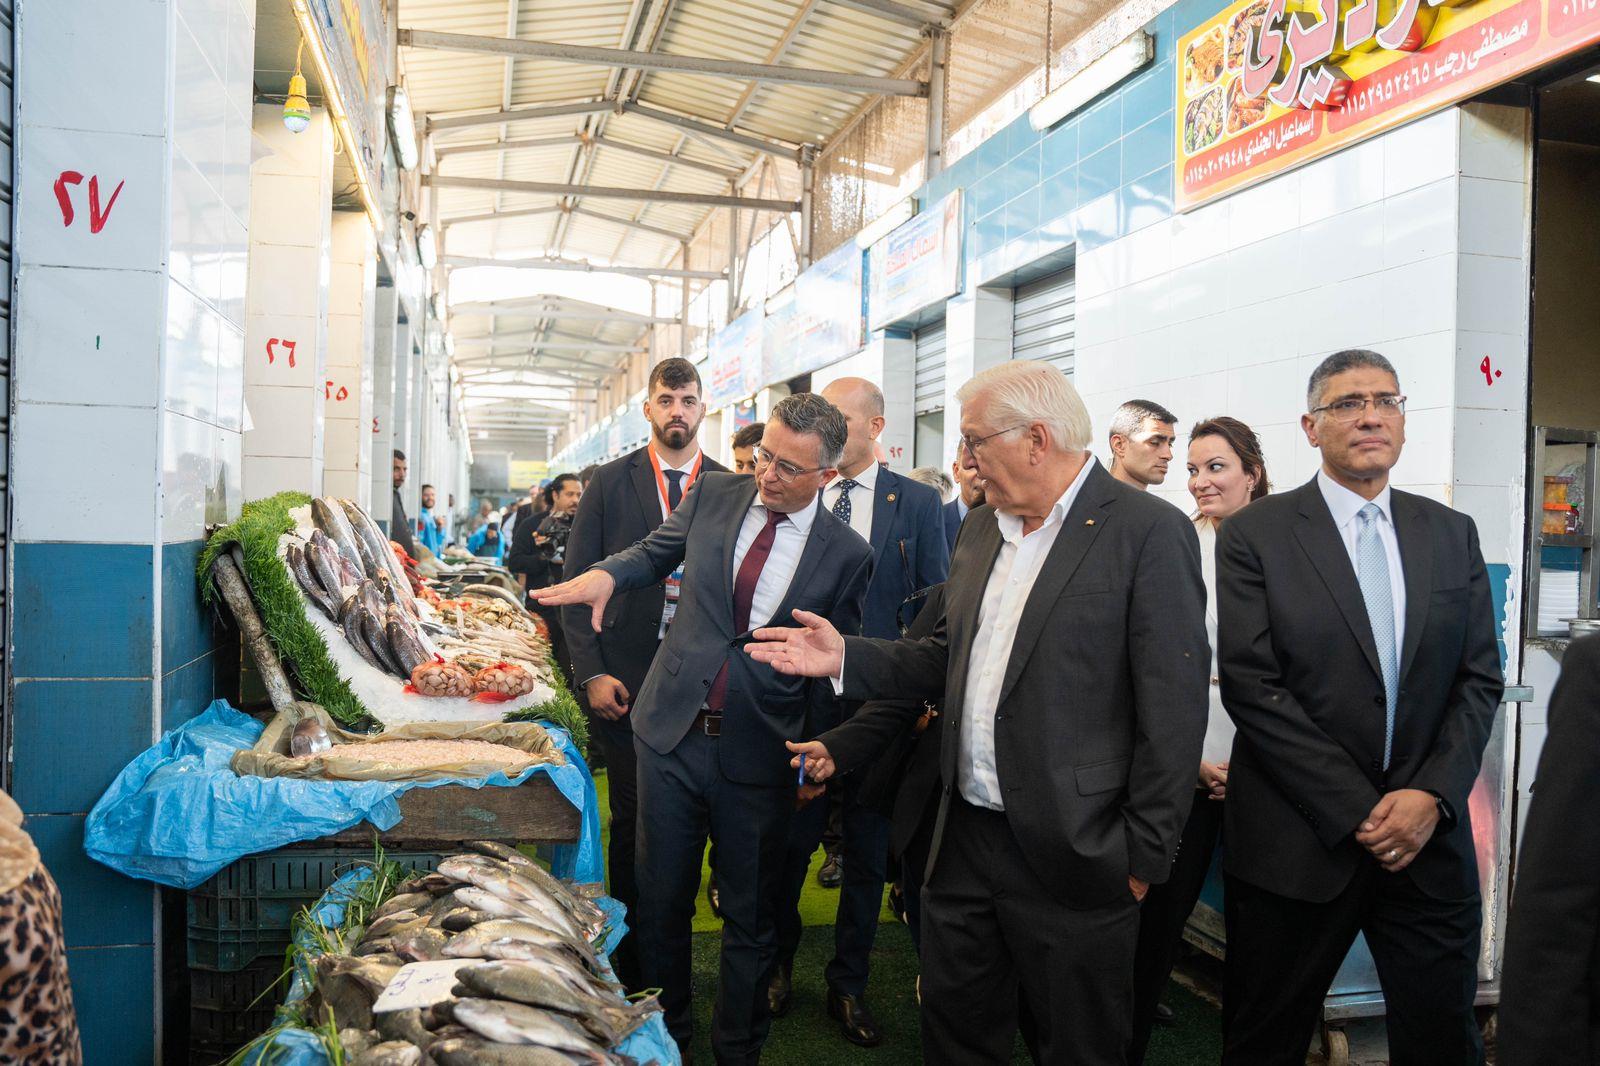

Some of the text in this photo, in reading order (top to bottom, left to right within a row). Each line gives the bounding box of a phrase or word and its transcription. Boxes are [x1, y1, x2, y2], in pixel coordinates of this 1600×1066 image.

[1466, 19, 1528, 70] مصطفى
[1434, 49, 1465, 81] رجب
[53, 170, 125, 234] ٢٧
[266, 338, 297, 368] ٢٦
[1480, 355, 1502, 386] ٩٠
[325, 380, 348, 401] ٢٥
